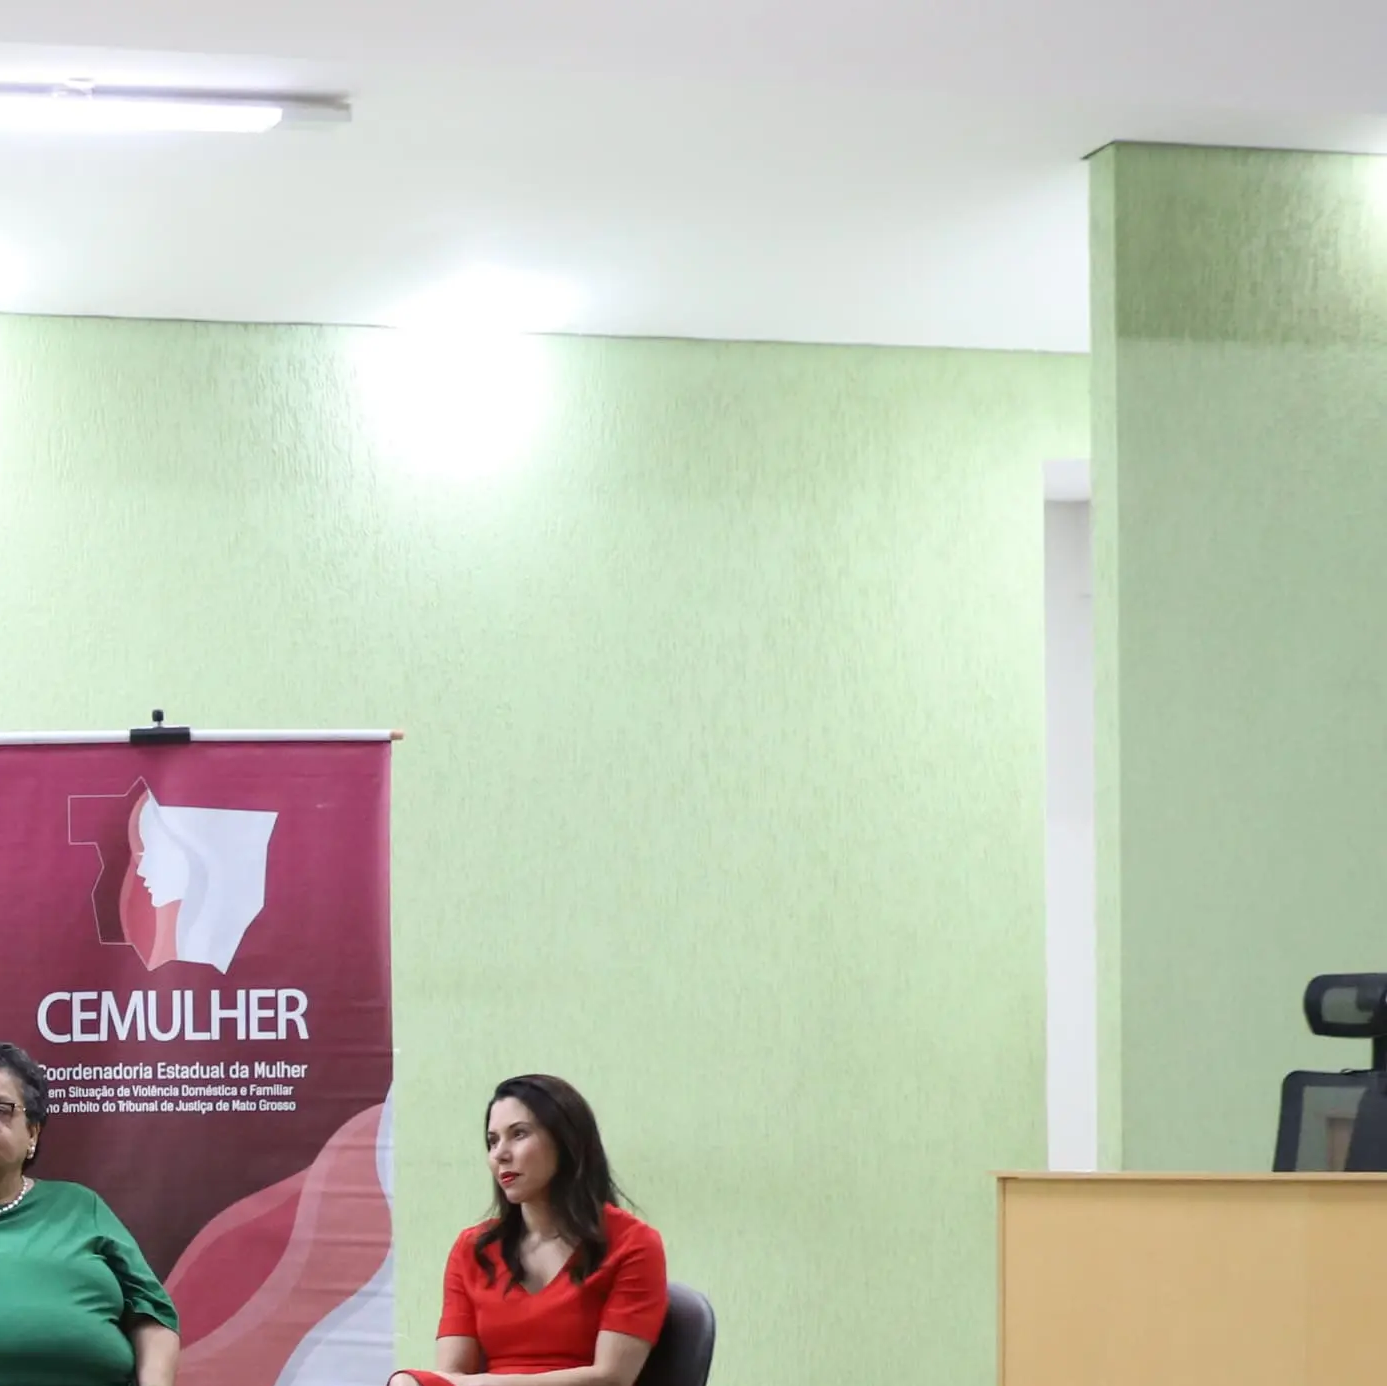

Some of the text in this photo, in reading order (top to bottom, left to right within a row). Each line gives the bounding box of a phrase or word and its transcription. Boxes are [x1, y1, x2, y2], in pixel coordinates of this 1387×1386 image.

[36, 988, 309, 1043] CEMULHER
[157, 1061, 225, 1080] Estadual
[229, 1061, 250, 1079] da
[254, 1061, 308, 1079] Mulher
[48, 1083, 295, 1100] em Situação de Violência Doméstica e Familiar
[62, 1101, 100, 1113] âmbito
[102, 1101, 115, 1113] do
[117, 1100, 158, 1113] Tribunal
[160, 1100, 174, 1112] de
[175, 1100, 213, 1115] Justiça
[215, 1100, 230, 1112] de
[231, 1099, 257, 1112] Mato
[258, 1098, 296, 1112] Grosso
